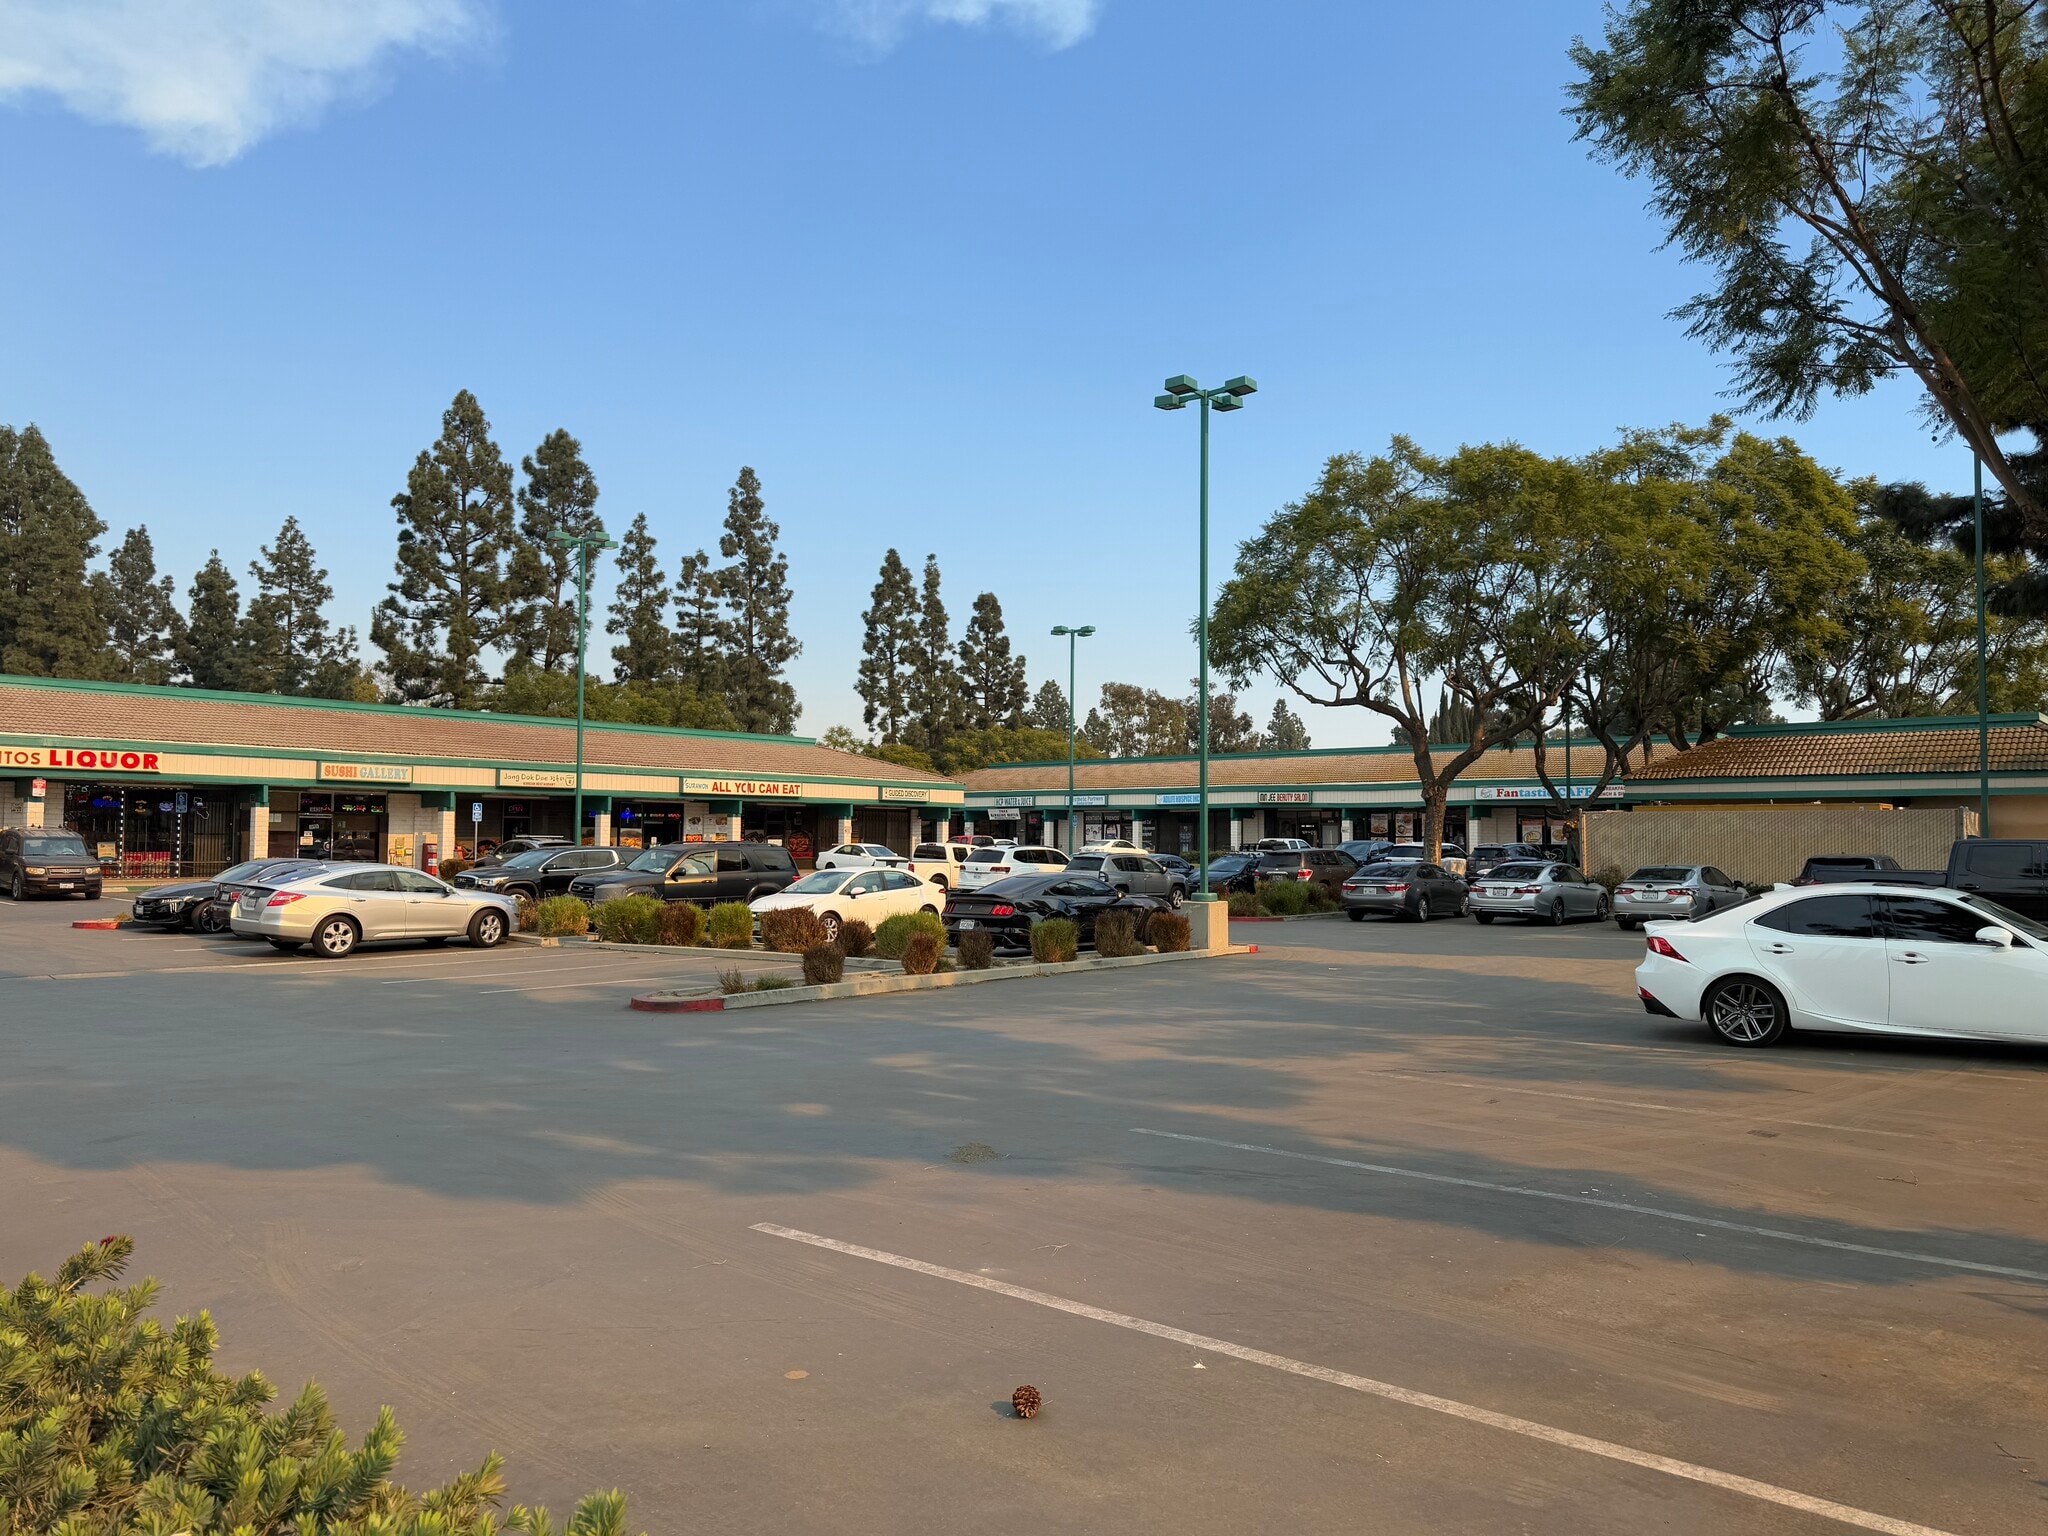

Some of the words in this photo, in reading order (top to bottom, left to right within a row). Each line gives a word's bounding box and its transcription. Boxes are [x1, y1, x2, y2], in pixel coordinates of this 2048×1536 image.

[49, 749, 159, 769] LIQUOR
[324, 765, 358, 778] SUSHI
[359, 767, 408, 779] GALLERY
[521, 773, 534, 781] Dok
[712, 781, 731, 793] ALL
[735, 782, 755, 793] YOU
[758, 783, 779, 794] CAN
[782, 784, 800, 795] EAT
[888, 789, 904, 797] GUIDED
[904, 790, 928, 798] DISCOVERY
[1268, 793, 1276, 801] JEE
[1276, 793, 1293, 801] BEAUTY
[1294, 793, 1308, 801] SALON
